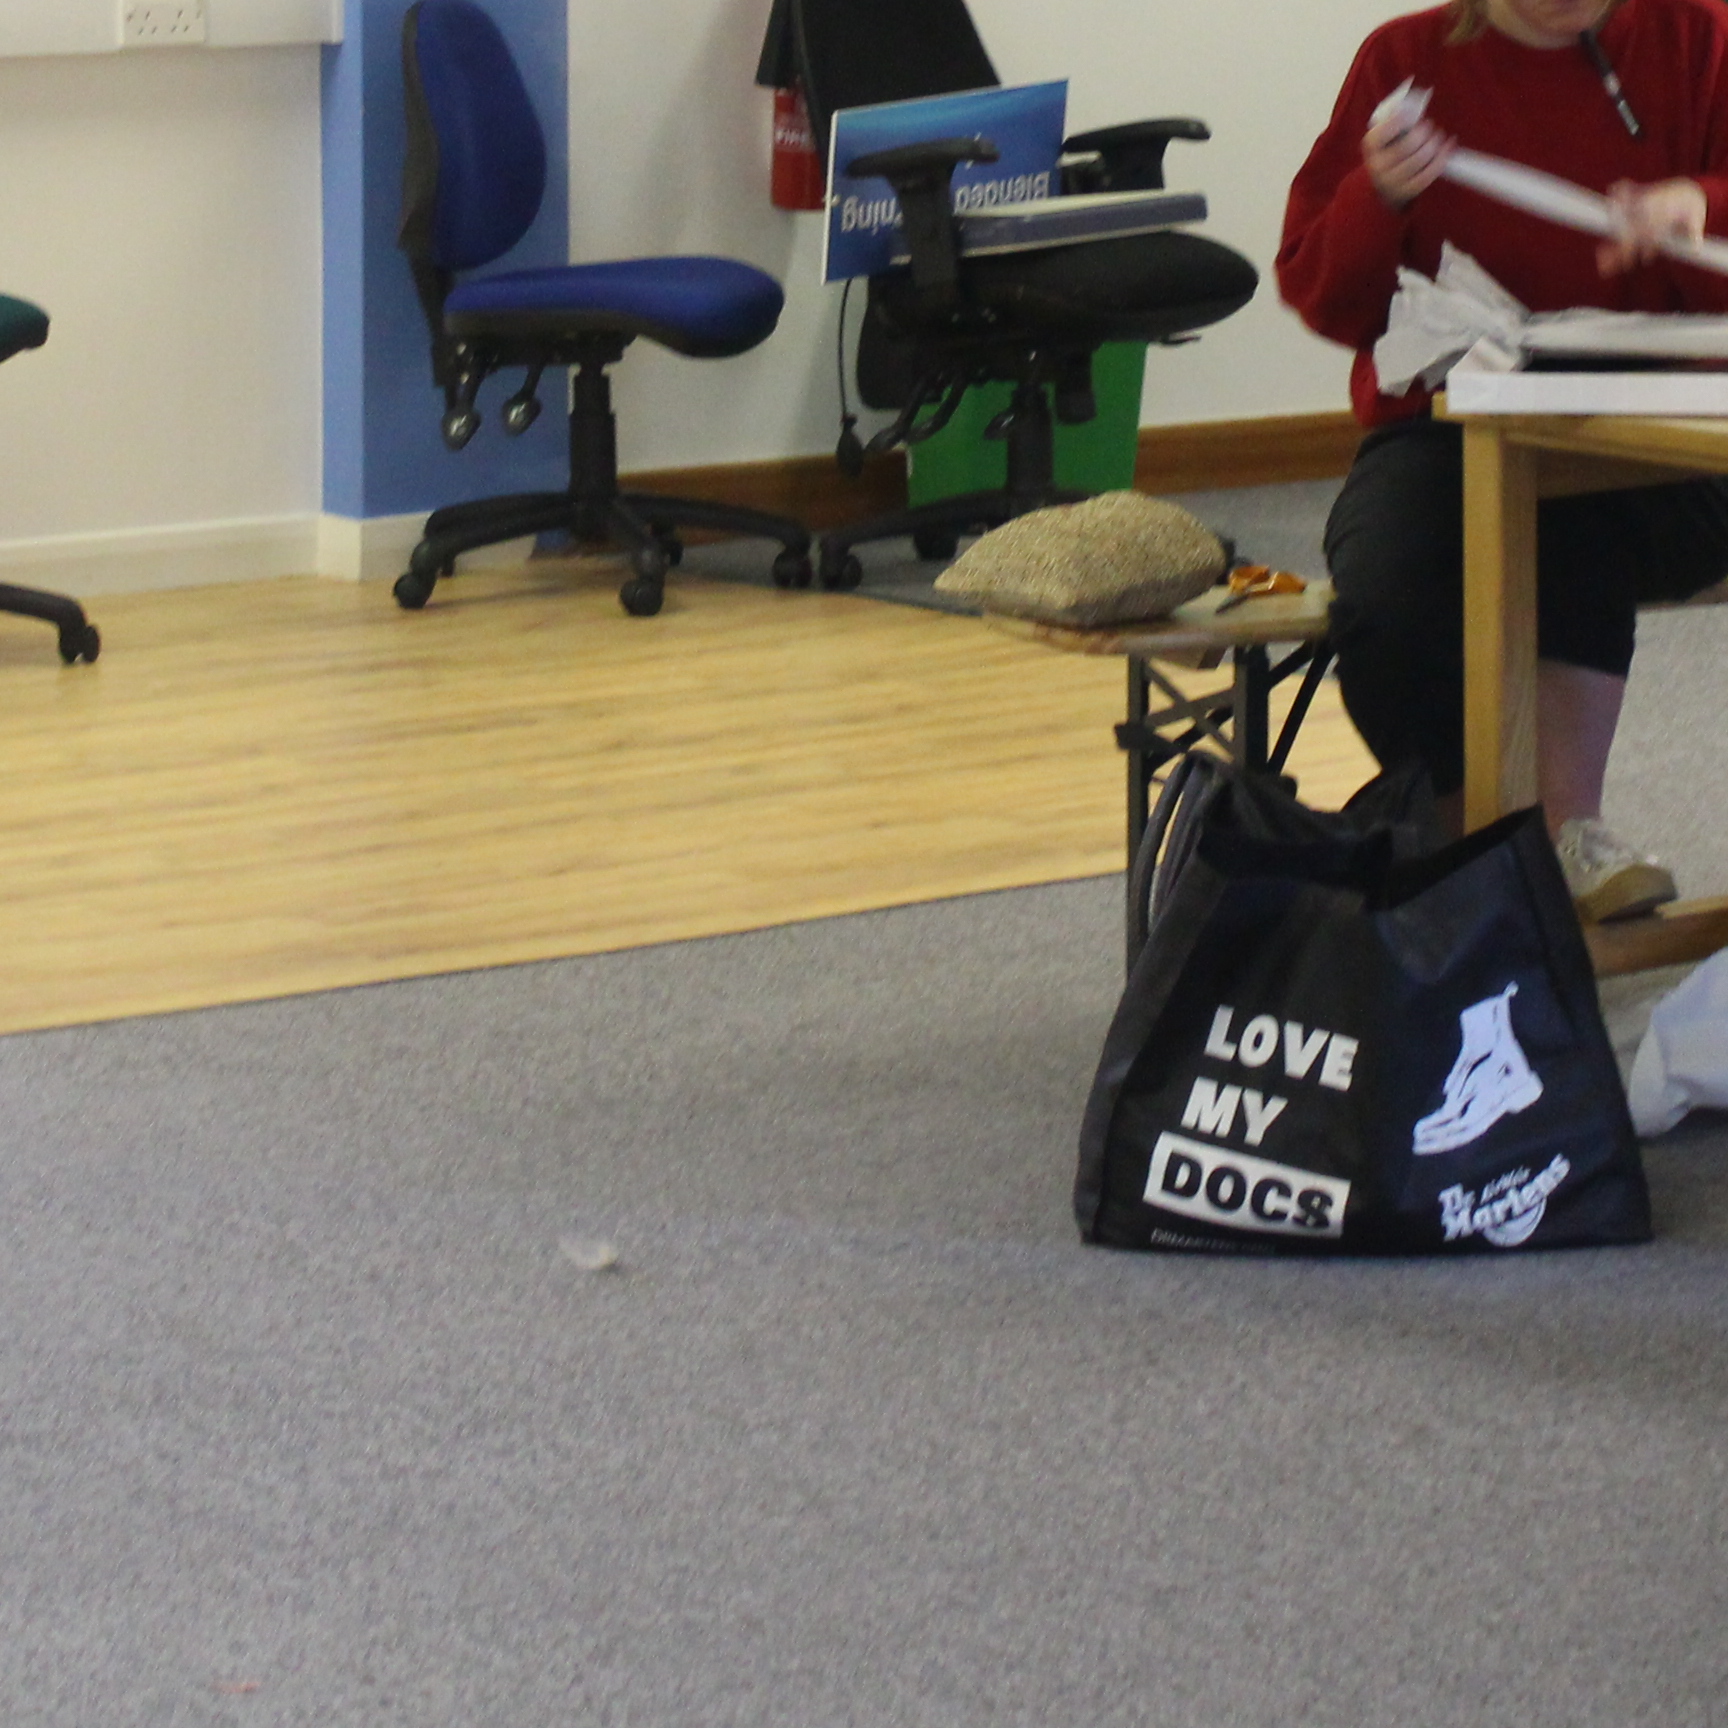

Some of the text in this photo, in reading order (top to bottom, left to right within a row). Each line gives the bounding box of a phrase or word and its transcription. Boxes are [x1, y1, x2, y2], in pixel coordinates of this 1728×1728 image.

[1203, 1004, 1360, 1092] LOVE
[1181, 1076, 1288, 1146] MY
[1160, 1148, 1335, 1232] DOCS
[1440, 1153, 1572, 1241] Martens
